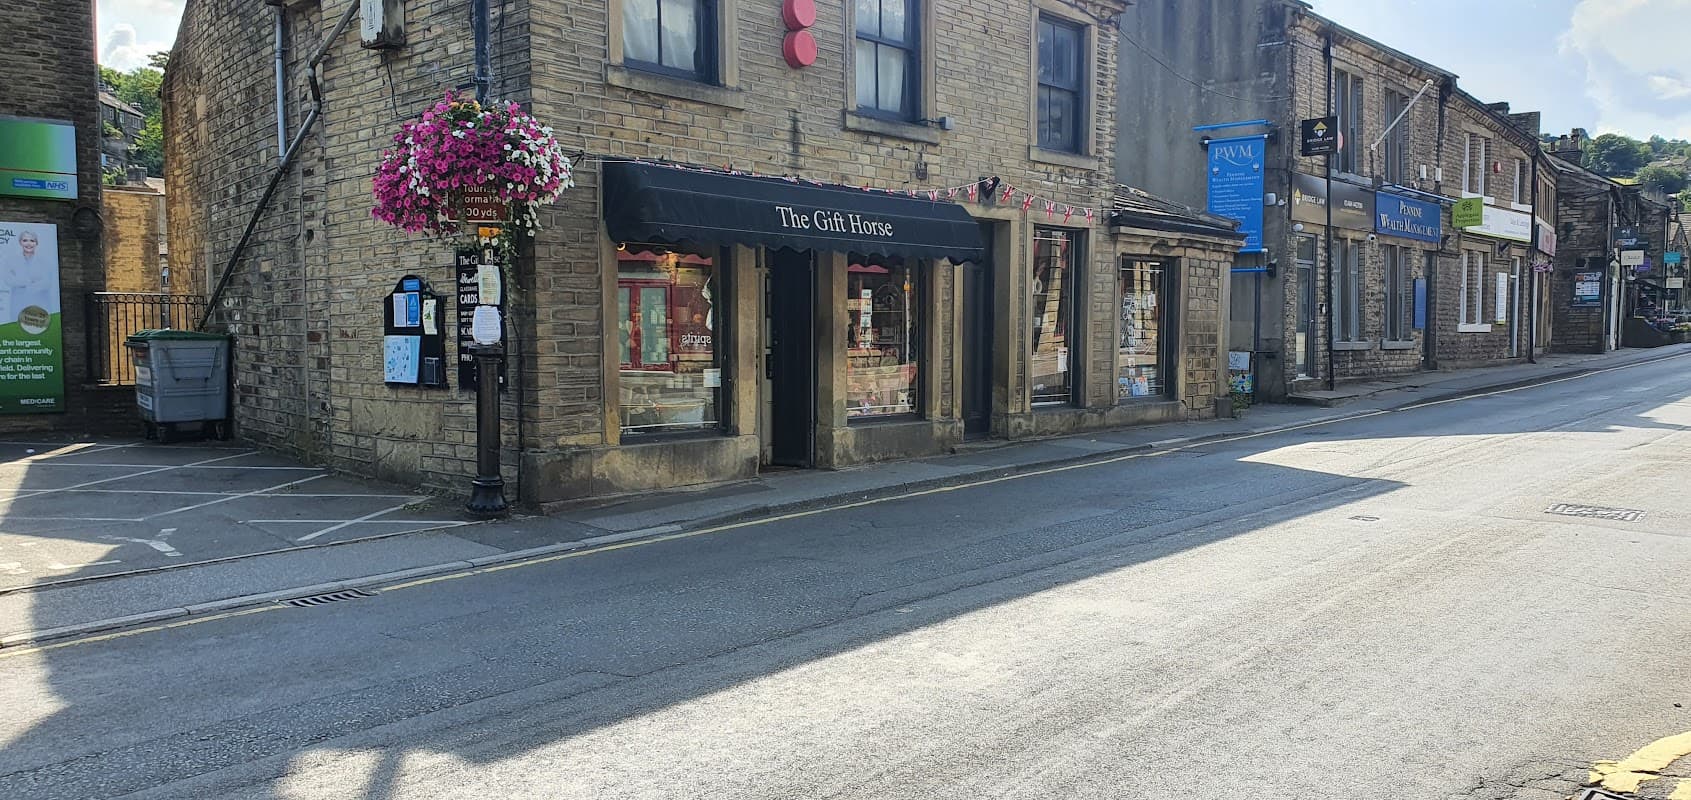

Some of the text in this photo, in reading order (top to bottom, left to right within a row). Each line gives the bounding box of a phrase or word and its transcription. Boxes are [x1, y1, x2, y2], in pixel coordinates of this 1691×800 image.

[1215, 145, 1253, 160] PWM
[47, 182, 66, 190] NHS
[481, 208, 497, 218] yds
[1399, 200, 1423, 218] PENNINE
[775, 205, 894, 237] The Gift Horse
[1380, 213, 1440, 238] WEALTH MANAGEMENT
[459, 255, 470, 266] The
[460, 293, 478, 304] CARDS
[15, 340, 41, 348] largest
[12, 348, 53, 356] community
[16, 364, 54, 372] Delivering
